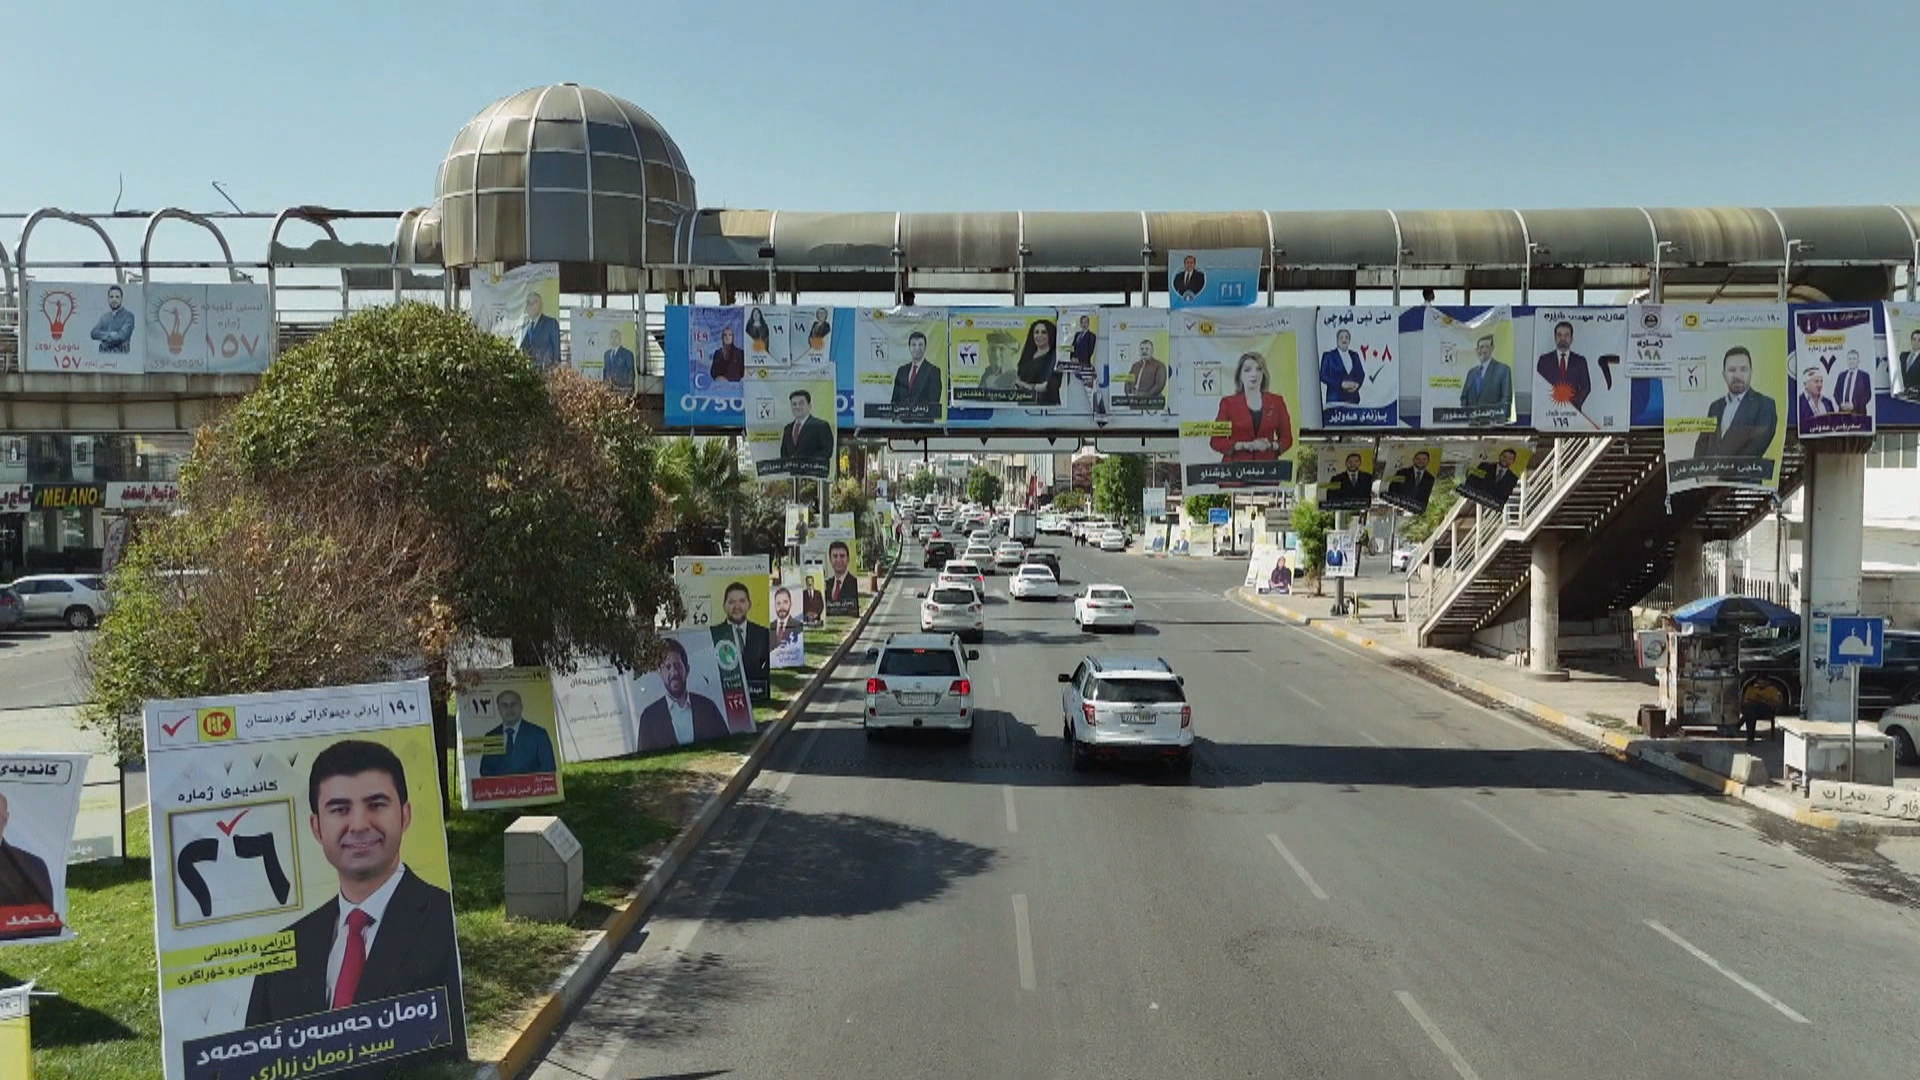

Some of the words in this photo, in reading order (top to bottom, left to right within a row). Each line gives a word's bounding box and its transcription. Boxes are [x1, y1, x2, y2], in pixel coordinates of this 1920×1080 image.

[205, 333, 259, 358] ١٥٧
[1360, 343, 1393, 362] ٢٠٨
[54, 355, 81, 369] ١٥٧
[1552, 417, 1569, 427] ١٦٩
[41, 487, 98, 507] MELANO
[354, 704, 381, 721] پارتی
[388, 698, 416, 717] ١٩٠
[245, 709, 297, 729] کوردستان
[177, 787, 214, 803] ژمارە
[221, 778, 279, 800] کاندیدی
[178, 832, 290, 917] ٢٦
[5, 912, 56, 927] محمد
[204, 942, 249, 962] ئاوەدانی
[260, 933, 292, 953] ئارامی
[376, 995, 438, 1029] زەمان
[288, 1016, 373, 1047] حەسەن
[196, 1025, 283, 1066] ئەحمەد
[358, 1038, 395, 1057] سید
[302, 1045, 355, 1072] زەمان
